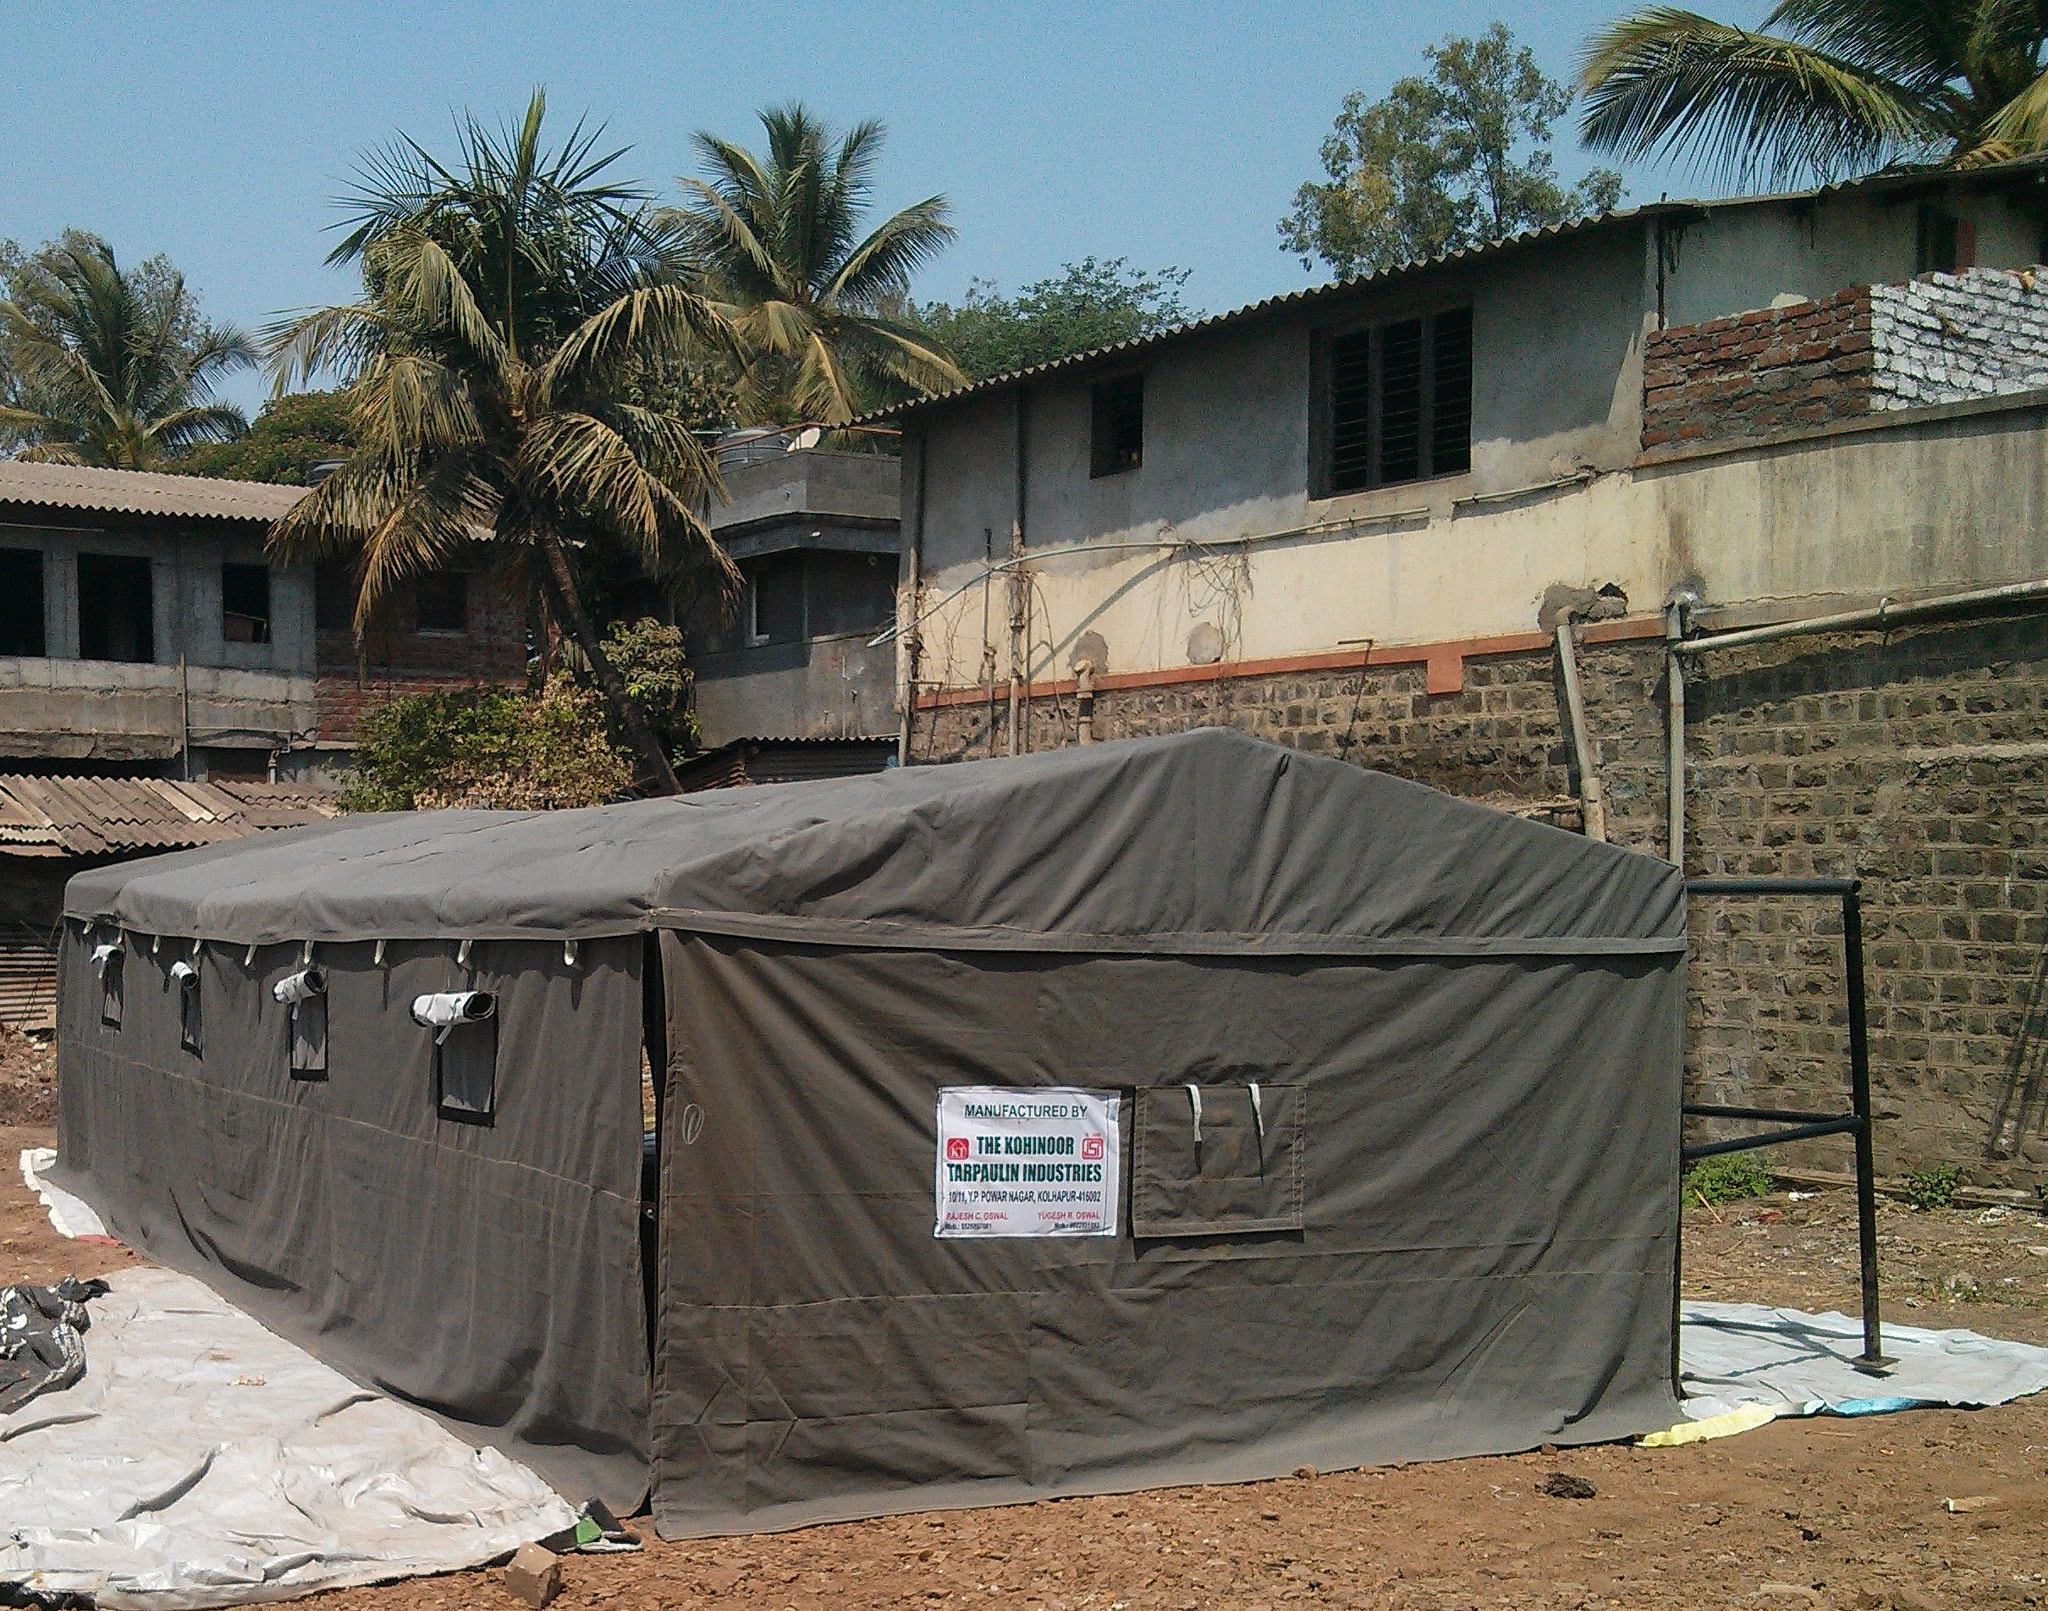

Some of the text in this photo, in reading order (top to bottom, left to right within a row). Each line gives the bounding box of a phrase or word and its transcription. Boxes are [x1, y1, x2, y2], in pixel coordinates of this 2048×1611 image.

[964, 1104, 1088, 1117] MANUFACTURED BY
[976, 1136, 1074, 1154] THE KOHINOOR
[947, 1163, 1102, 1182] TARPAULIN INDUSTRIES
[981, 1191, 1007, 1203] POWAR
[1008, 1191, 1036, 1204] NAGAR,
[946, 1212, 1009, 1220] RAJESH C. OSWAL
[1038, 1211, 1100, 1220] YUGESH R. OSWAL
